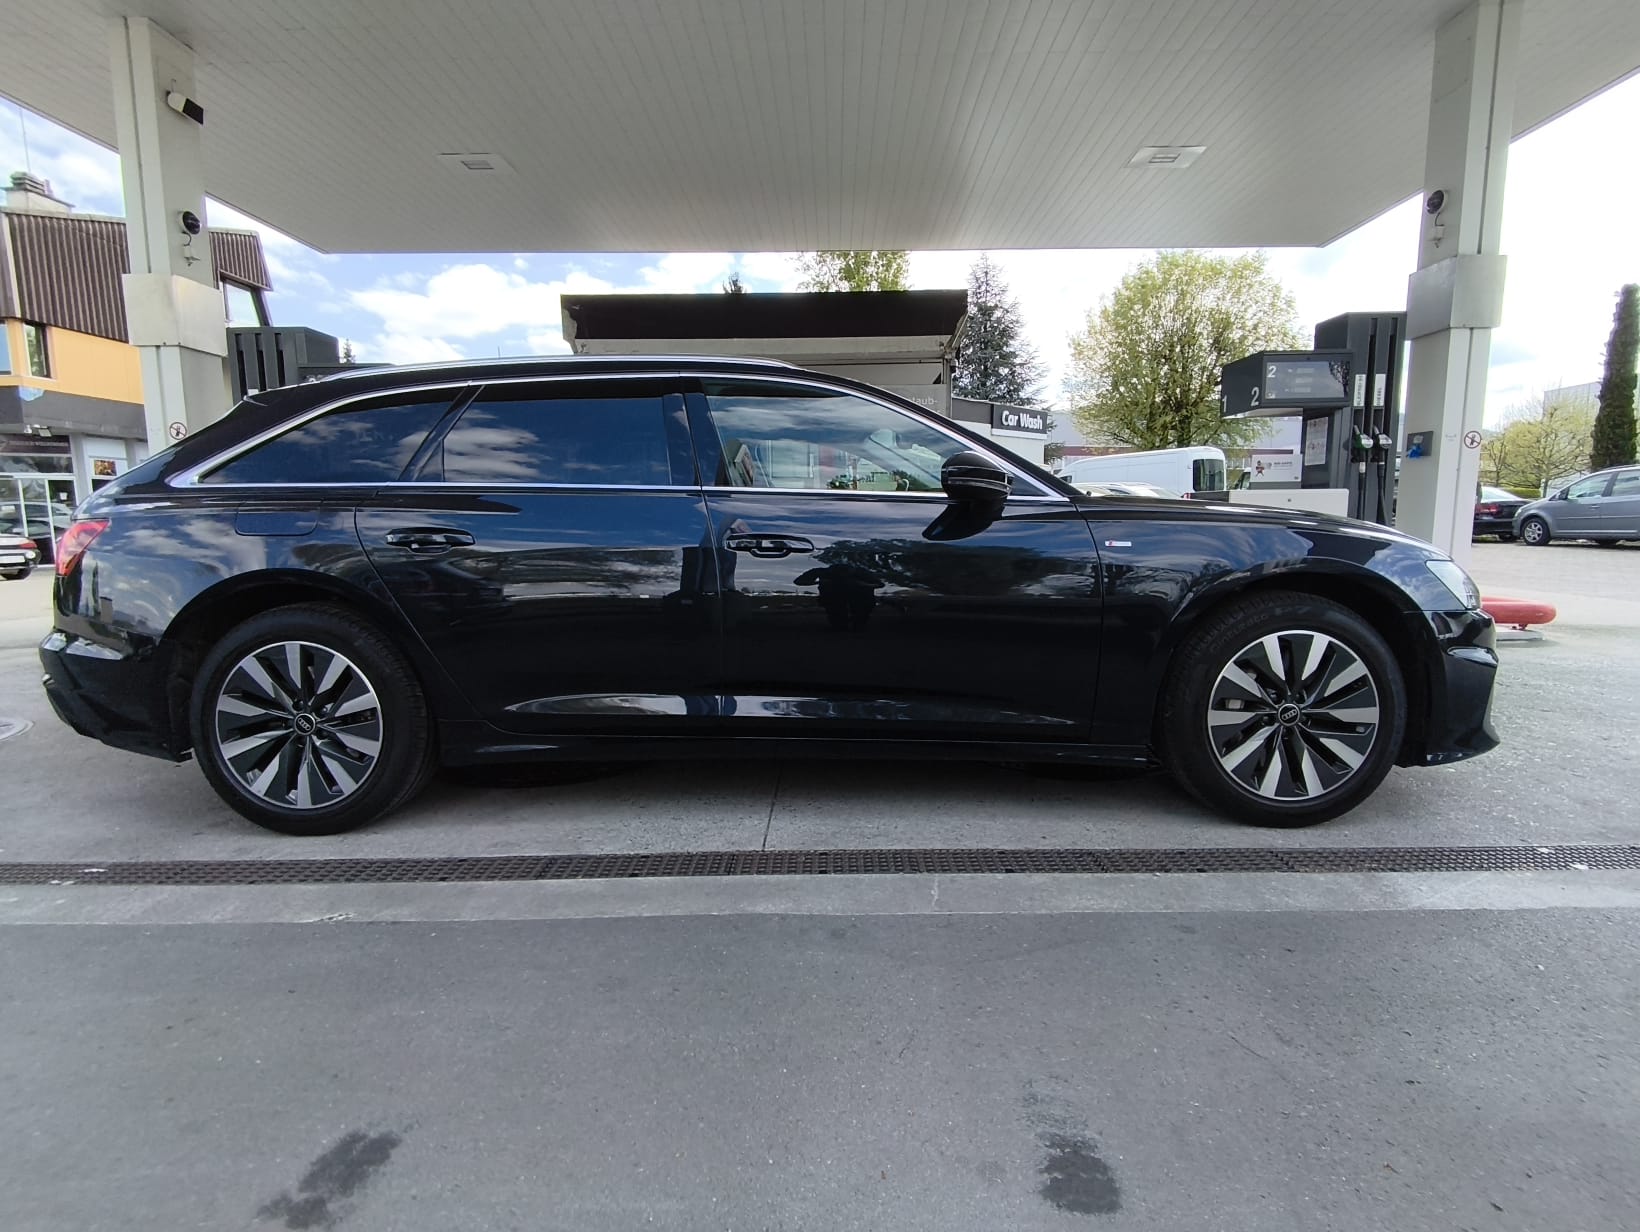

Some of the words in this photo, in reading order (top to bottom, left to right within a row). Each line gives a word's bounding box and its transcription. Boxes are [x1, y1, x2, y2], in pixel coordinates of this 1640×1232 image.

[1267, 366, 1277, 378] 2
[1222, 395, 1229, 413] 1
[1250, 386, 1260, 407] 2
[1002, 410, 1019, 426] Car
[1020, 413, 1043, 430] Wash
